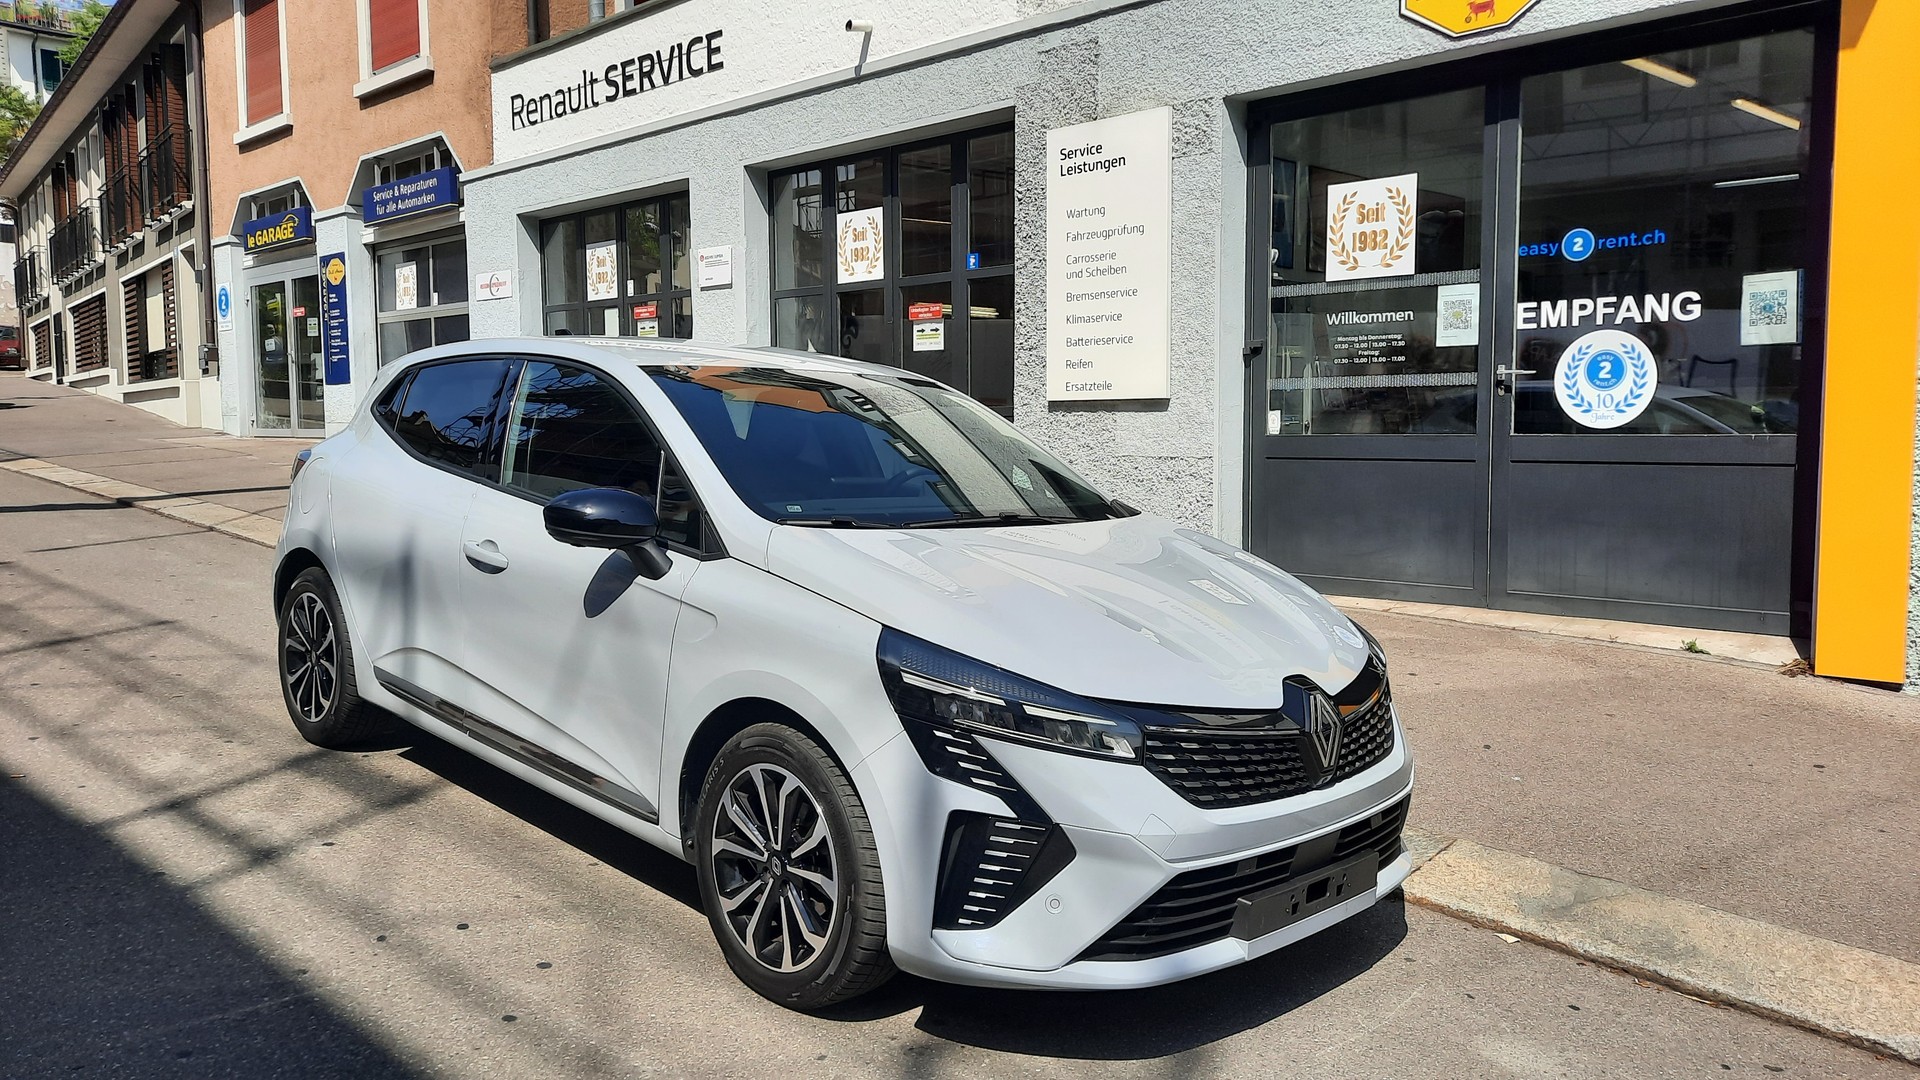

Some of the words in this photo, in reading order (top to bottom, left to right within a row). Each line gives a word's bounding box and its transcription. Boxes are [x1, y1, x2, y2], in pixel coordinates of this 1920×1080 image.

[510, 69, 599, 131] Renault
[604, 29, 724, 102] SERVICE
[1060, 143, 1103, 161] Service
[1060, 156, 1126, 177] Leistungen
[373, 189, 393, 202] Service
[394, 185, 399, 197] &
[400, 177, 438, 196] Reparaturen
[376, 204, 385, 215] für
[386, 200, 396, 213] alle
[397, 193, 436, 209] Automarken
[1066, 206, 1106, 219] Wartung
[1356, 201, 1386, 225] Seit
[247, 233, 256, 248] le
[256, 222, 295, 246] GARAGE
[852, 226, 868, 243] Seit
[1066, 223, 1145, 242] Fahrzeugprüfung
[1352, 229, 1389, 252] 1982
[1519, 241, 1559, 257] easy
[1572, 237, 1584, 252] 2
[1598, 229, 1666, 249] rent.ch
[1066, 250, 1117, 265] Carrosserie
[1066, 268, 1084, 280] und
[1085, 264, 1127, 279] Scheiben
[1066, 287, 1138, 302] Bremsenservice
[1066, 312, 1122, 324] Klimaservice
[1326, 310, 1414, 326] Willkommen
[1516, 291, 1702, 330] EMPFANG
[1066, 334, 1134, 347] Batterieservice
[1065, 359, 1093, 370] Reifen
[1598, 361, 1612, 378] 2
[1065, 381, 1113, 392] Ersatzteile
[1596, 393, 1614, 409] 10
